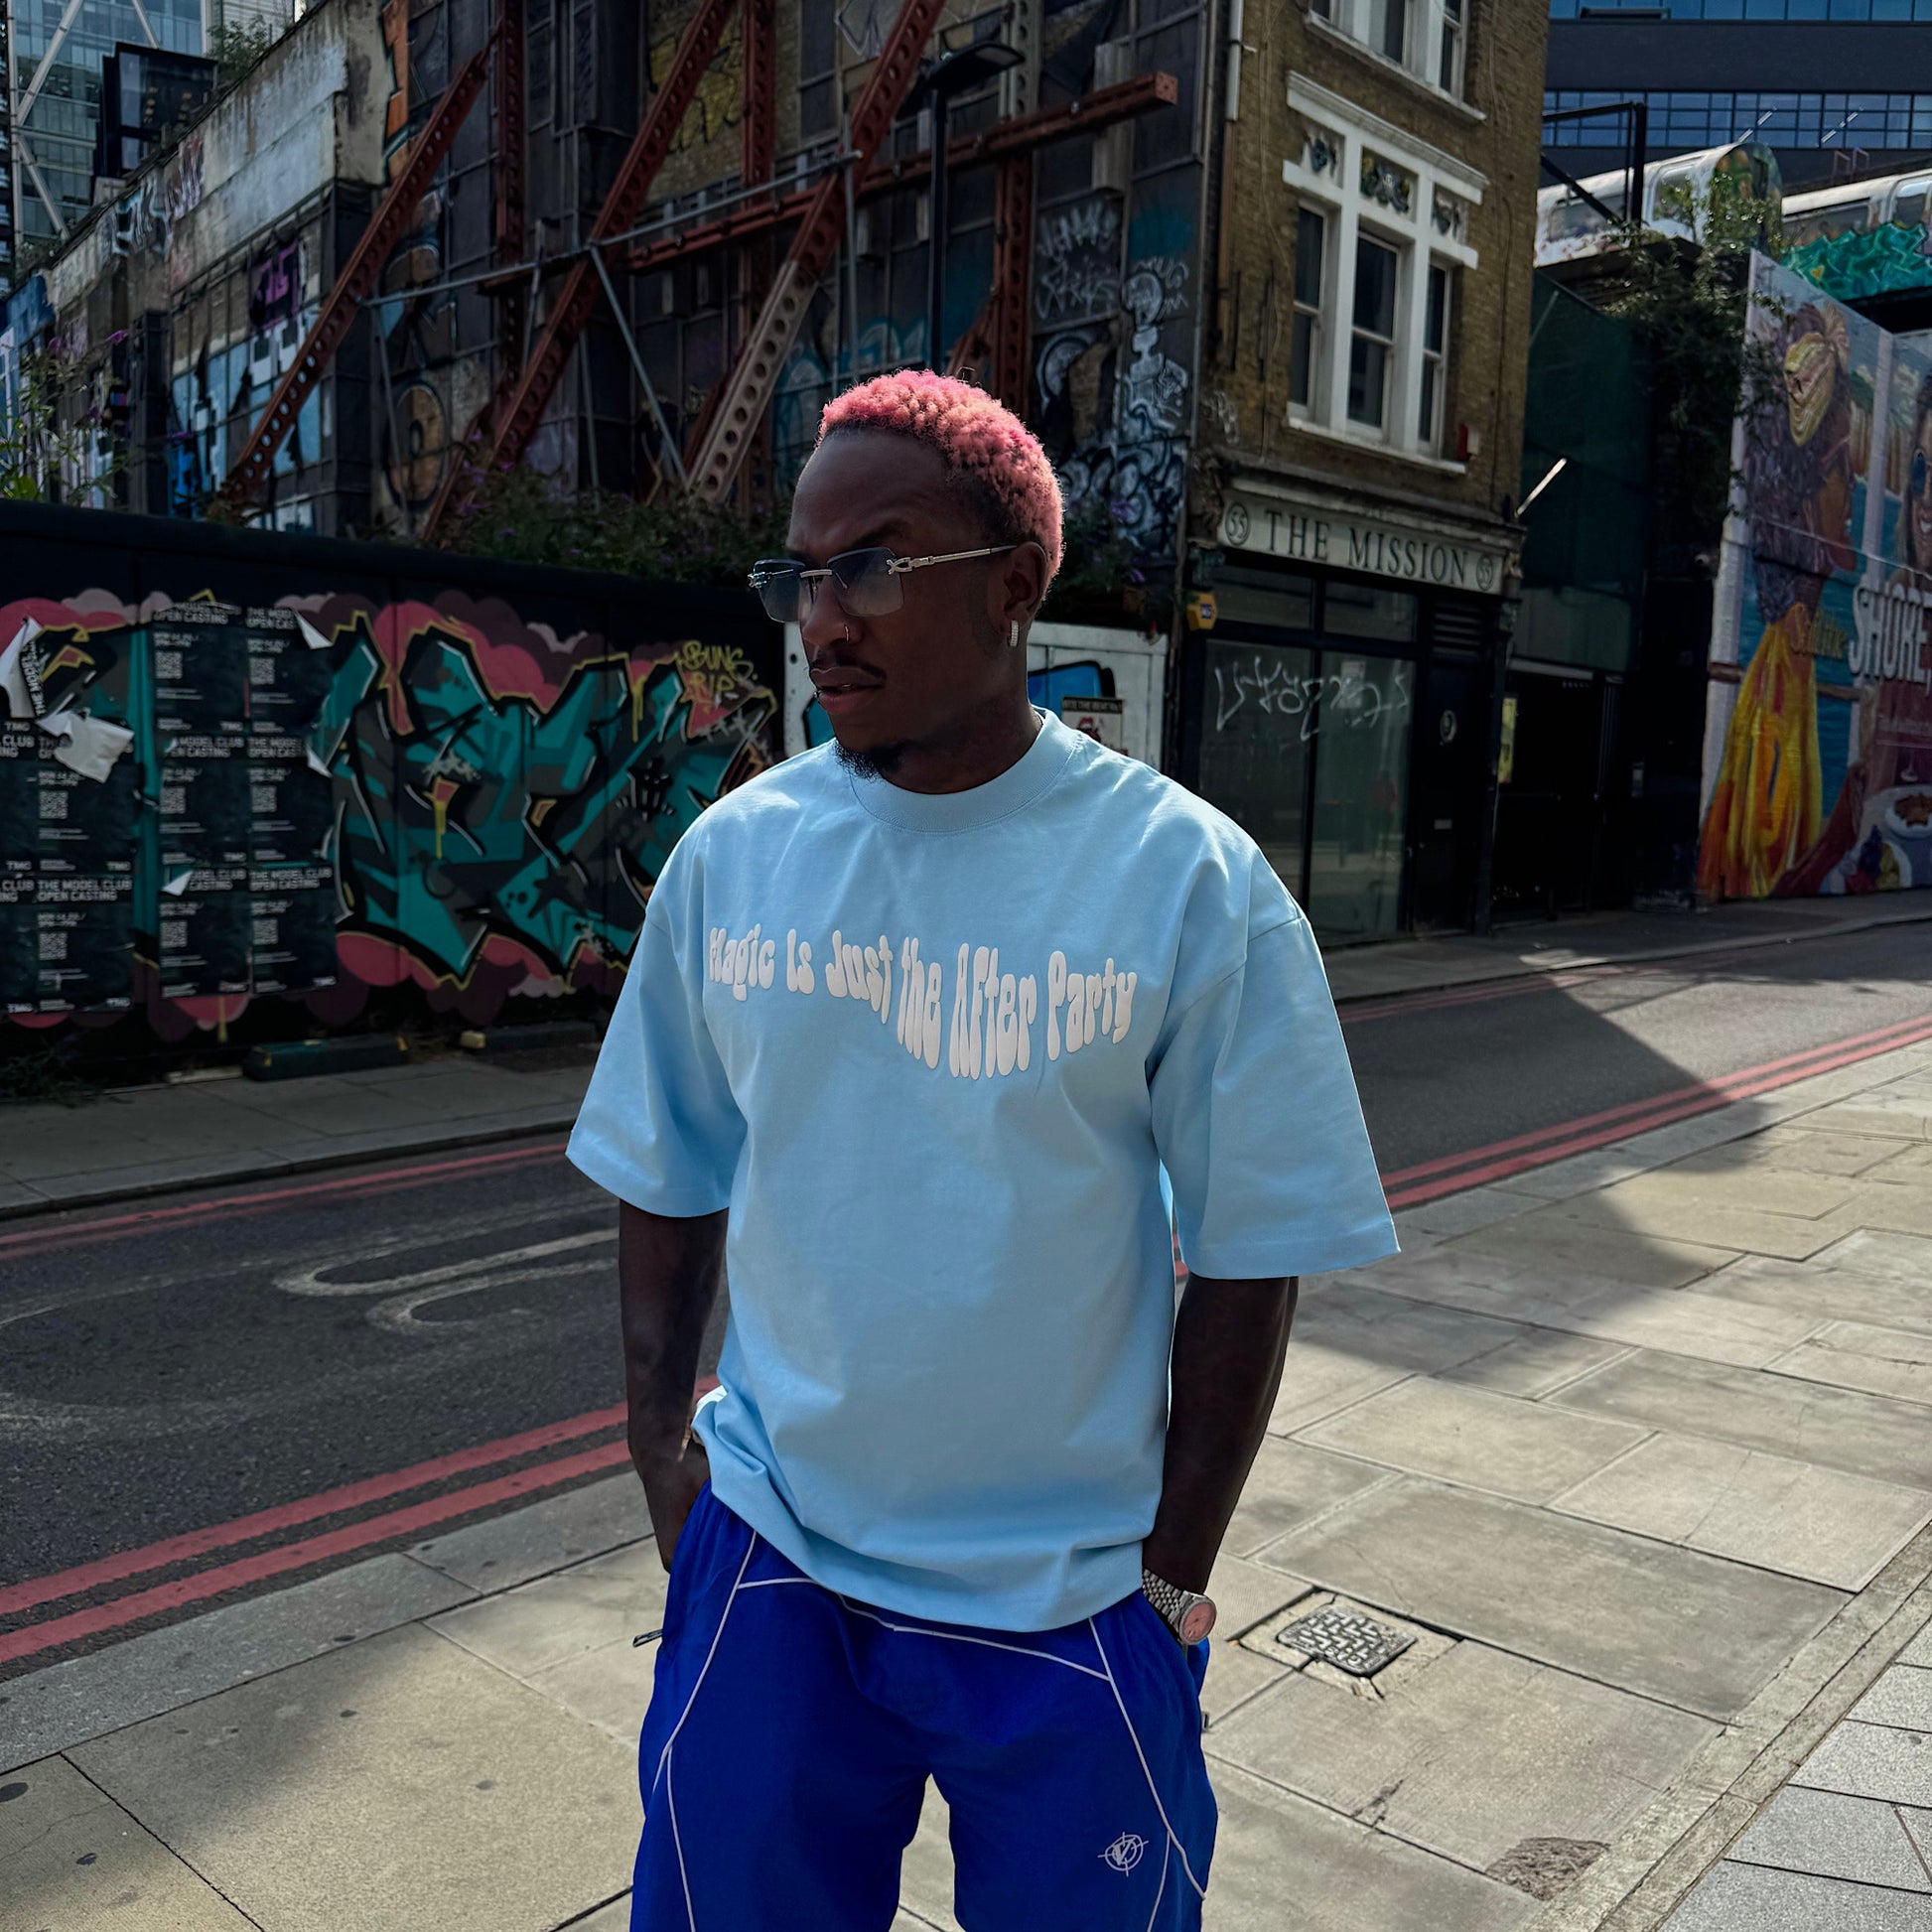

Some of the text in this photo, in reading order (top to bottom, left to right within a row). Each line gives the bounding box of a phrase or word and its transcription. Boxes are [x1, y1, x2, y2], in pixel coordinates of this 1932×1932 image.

[1265, 510, 1329, 562] THE
[1348, 527, 1469, 586] MISSION
[2, 735, 35, 748] CLUB
[2, 880, 35, 892] CLUB
[37, 879, 132, 891] THE MODEL CLUB
[37, 890, 117, 901] OPEN CASTING
[709, 923, 1137, 1080] Magic Is Just the After Party
